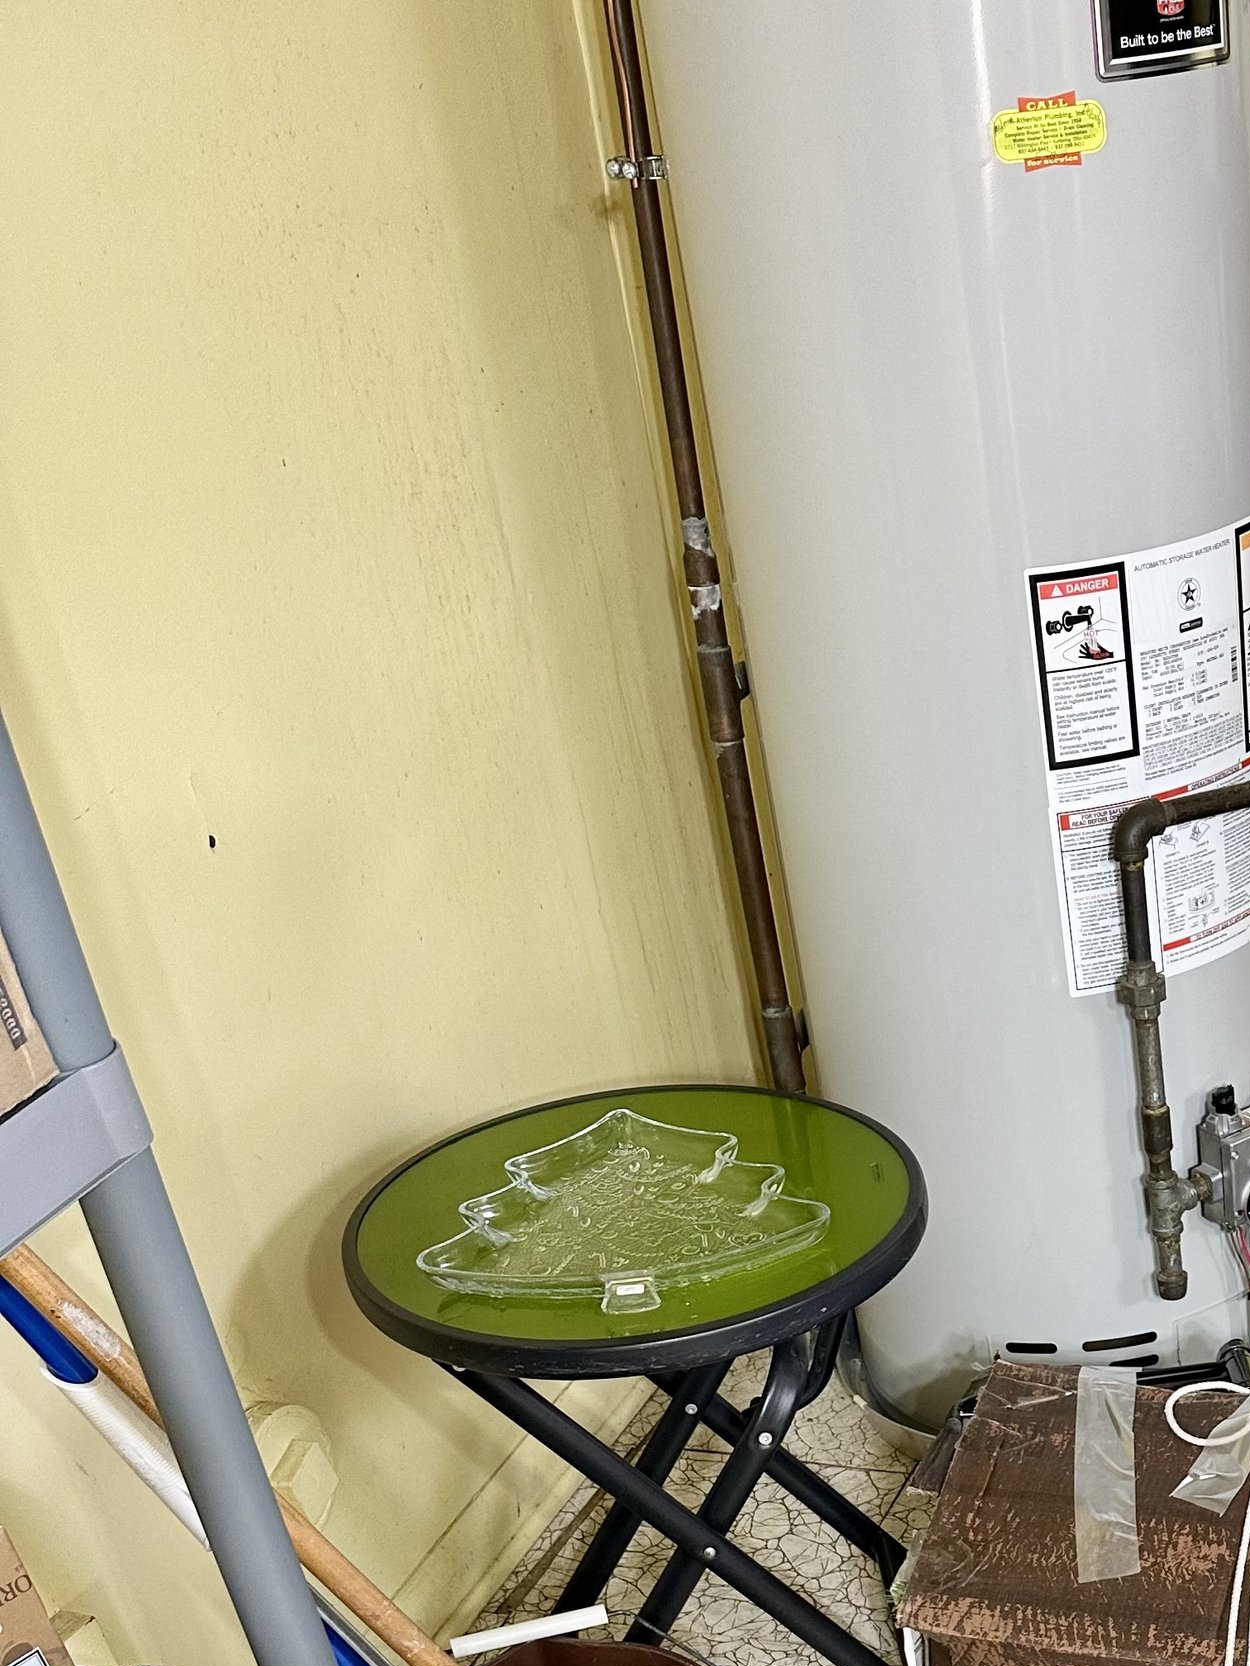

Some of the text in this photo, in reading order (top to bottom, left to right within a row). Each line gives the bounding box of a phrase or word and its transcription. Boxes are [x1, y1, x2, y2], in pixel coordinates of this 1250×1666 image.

[1120, 35, 1145, 49] Built
[1147, 33, 1159, 46] to
[1160, 30, 1174, 44] be
[1176, 28, 1192, 42] the
[1026, 98, 1069, 111] CALL
[1043, 154, 1078, 164] service
[1133, 559, 1167, 573] AUTOMATIC
[1168, 551, 1194, 564] STORAGE
[1065, 578, 1109, 594] DANGER
